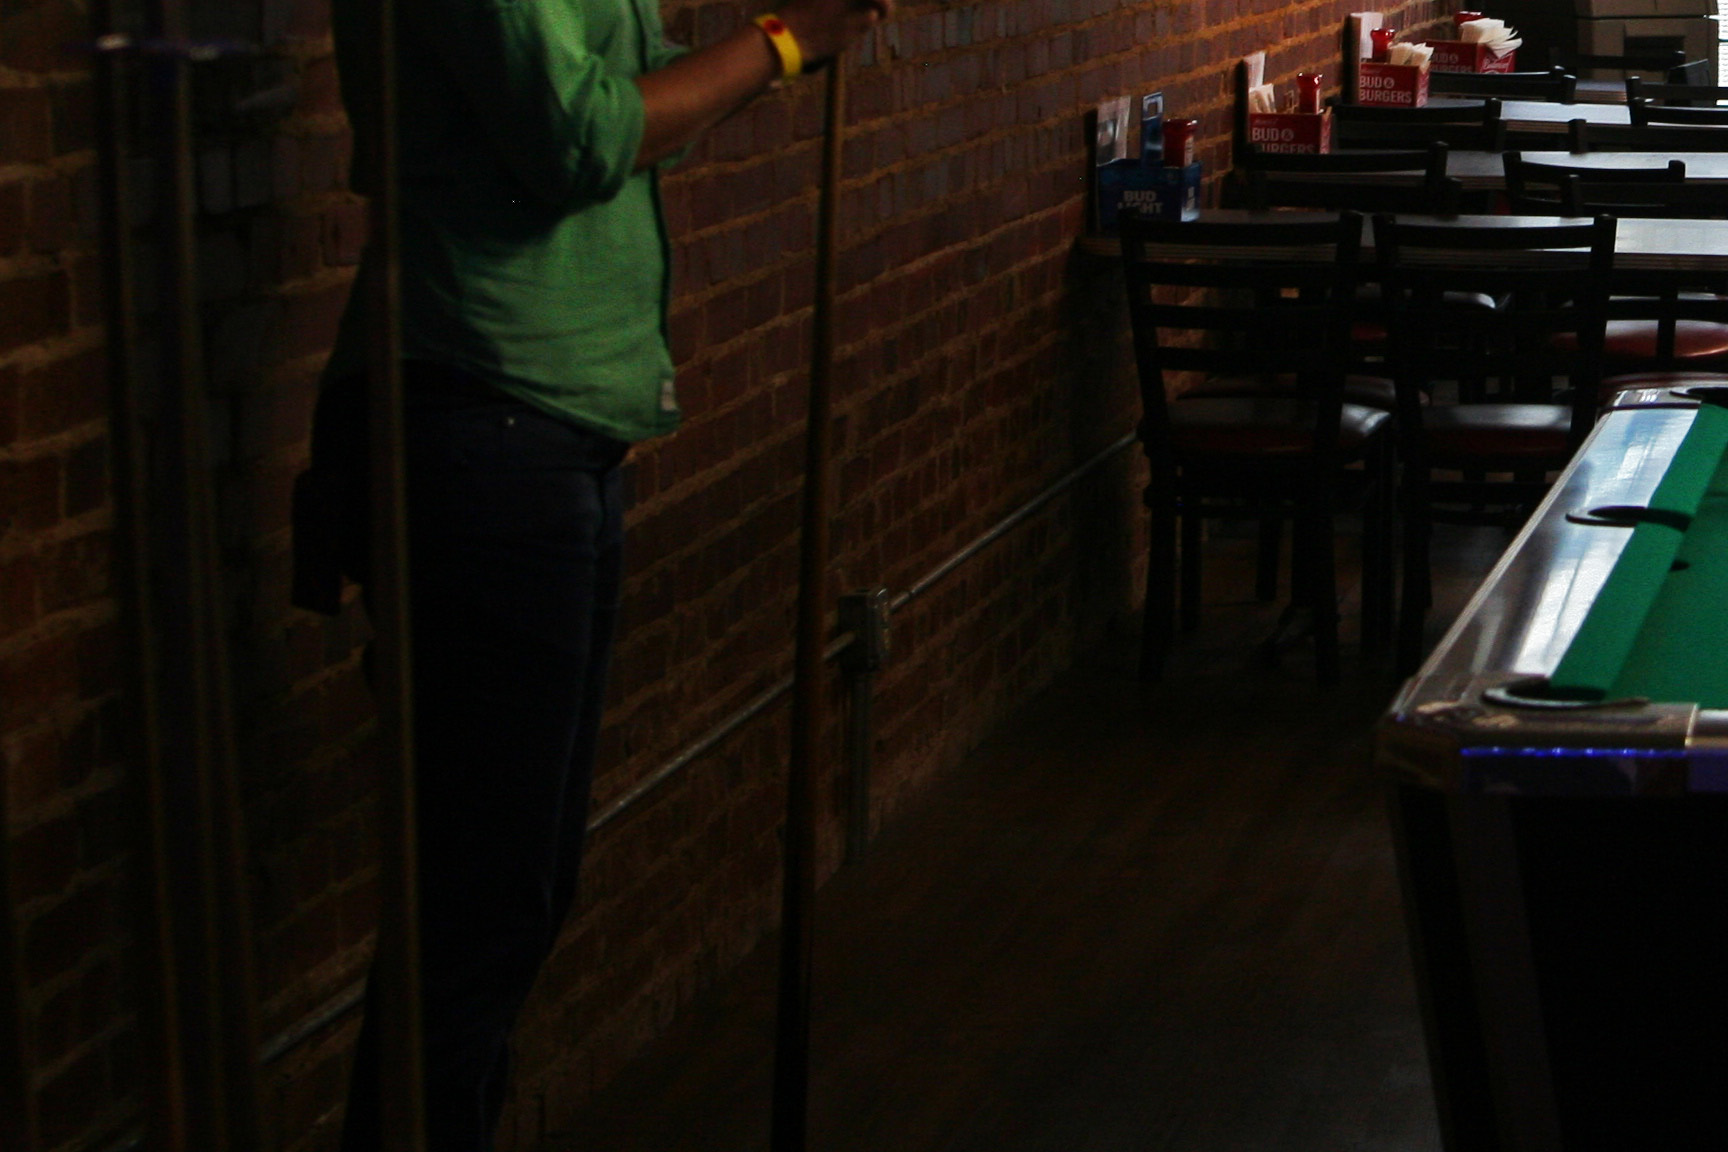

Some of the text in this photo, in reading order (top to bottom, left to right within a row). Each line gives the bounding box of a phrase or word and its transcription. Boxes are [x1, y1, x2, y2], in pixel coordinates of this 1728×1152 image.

[1360, 76, 1382, 88] BUD
[1360, 91, 1413, 104] BURGERS
[1252, 128, 1279, 141] BUD
[1253, 142, 1316, 154] URGERS
[1123, 190, 1157, 202] BUD
